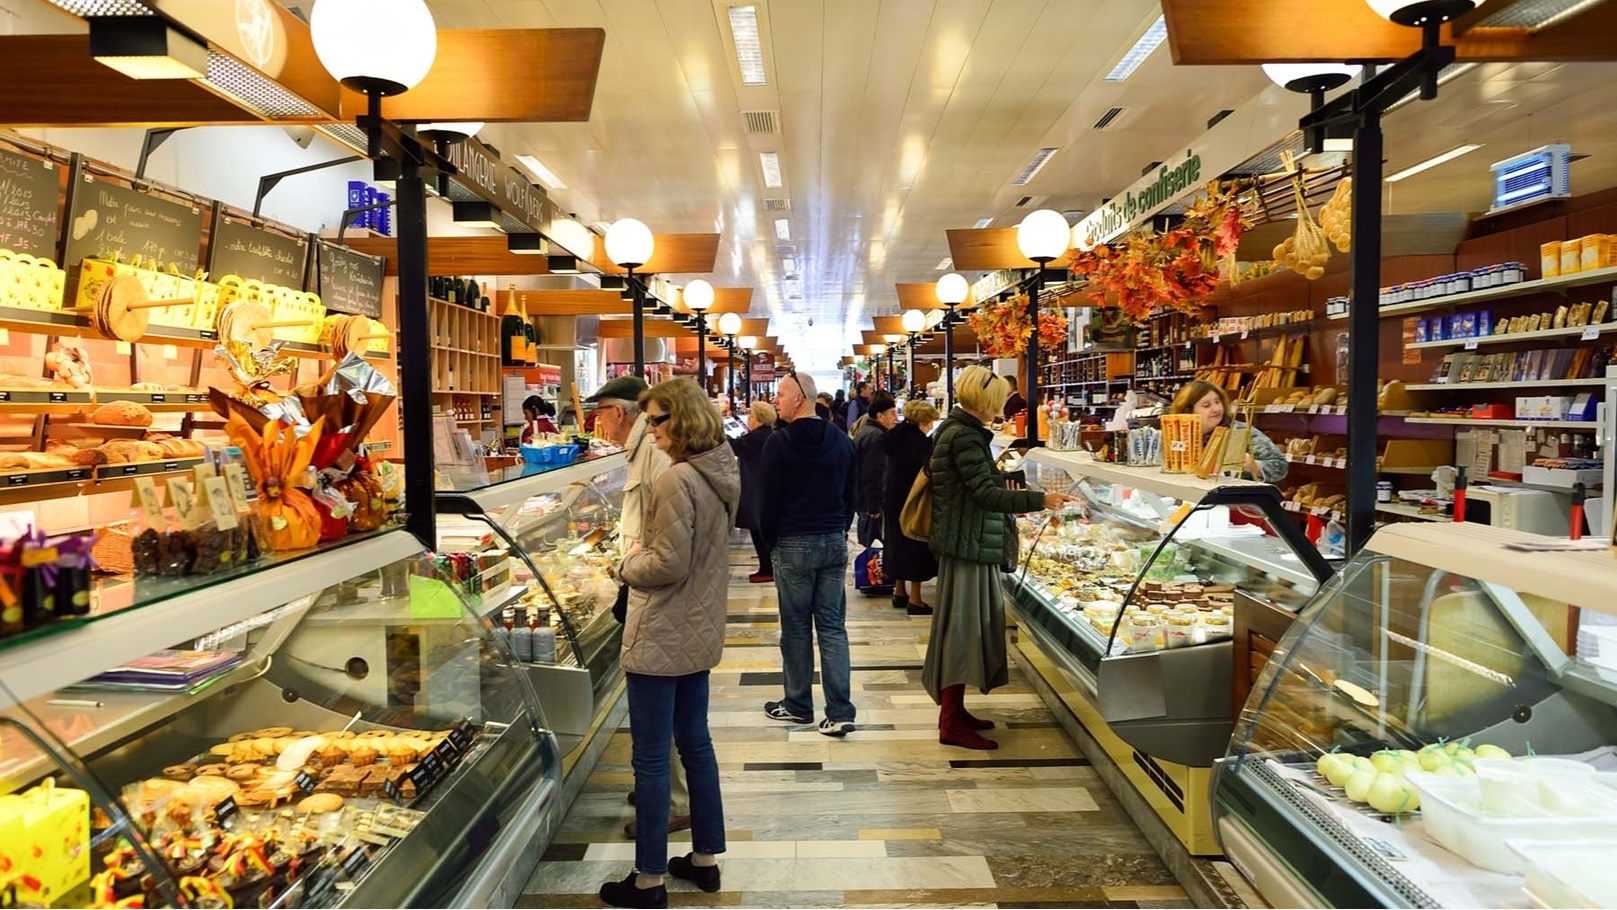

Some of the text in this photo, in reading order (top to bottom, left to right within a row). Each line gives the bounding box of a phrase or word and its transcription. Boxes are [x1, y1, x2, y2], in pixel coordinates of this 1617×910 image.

[440, 138, 497, 195] ULANGERIE
[1123, 191, 1137, 224] de
[1138, 149, 1201, 215] confiserie
